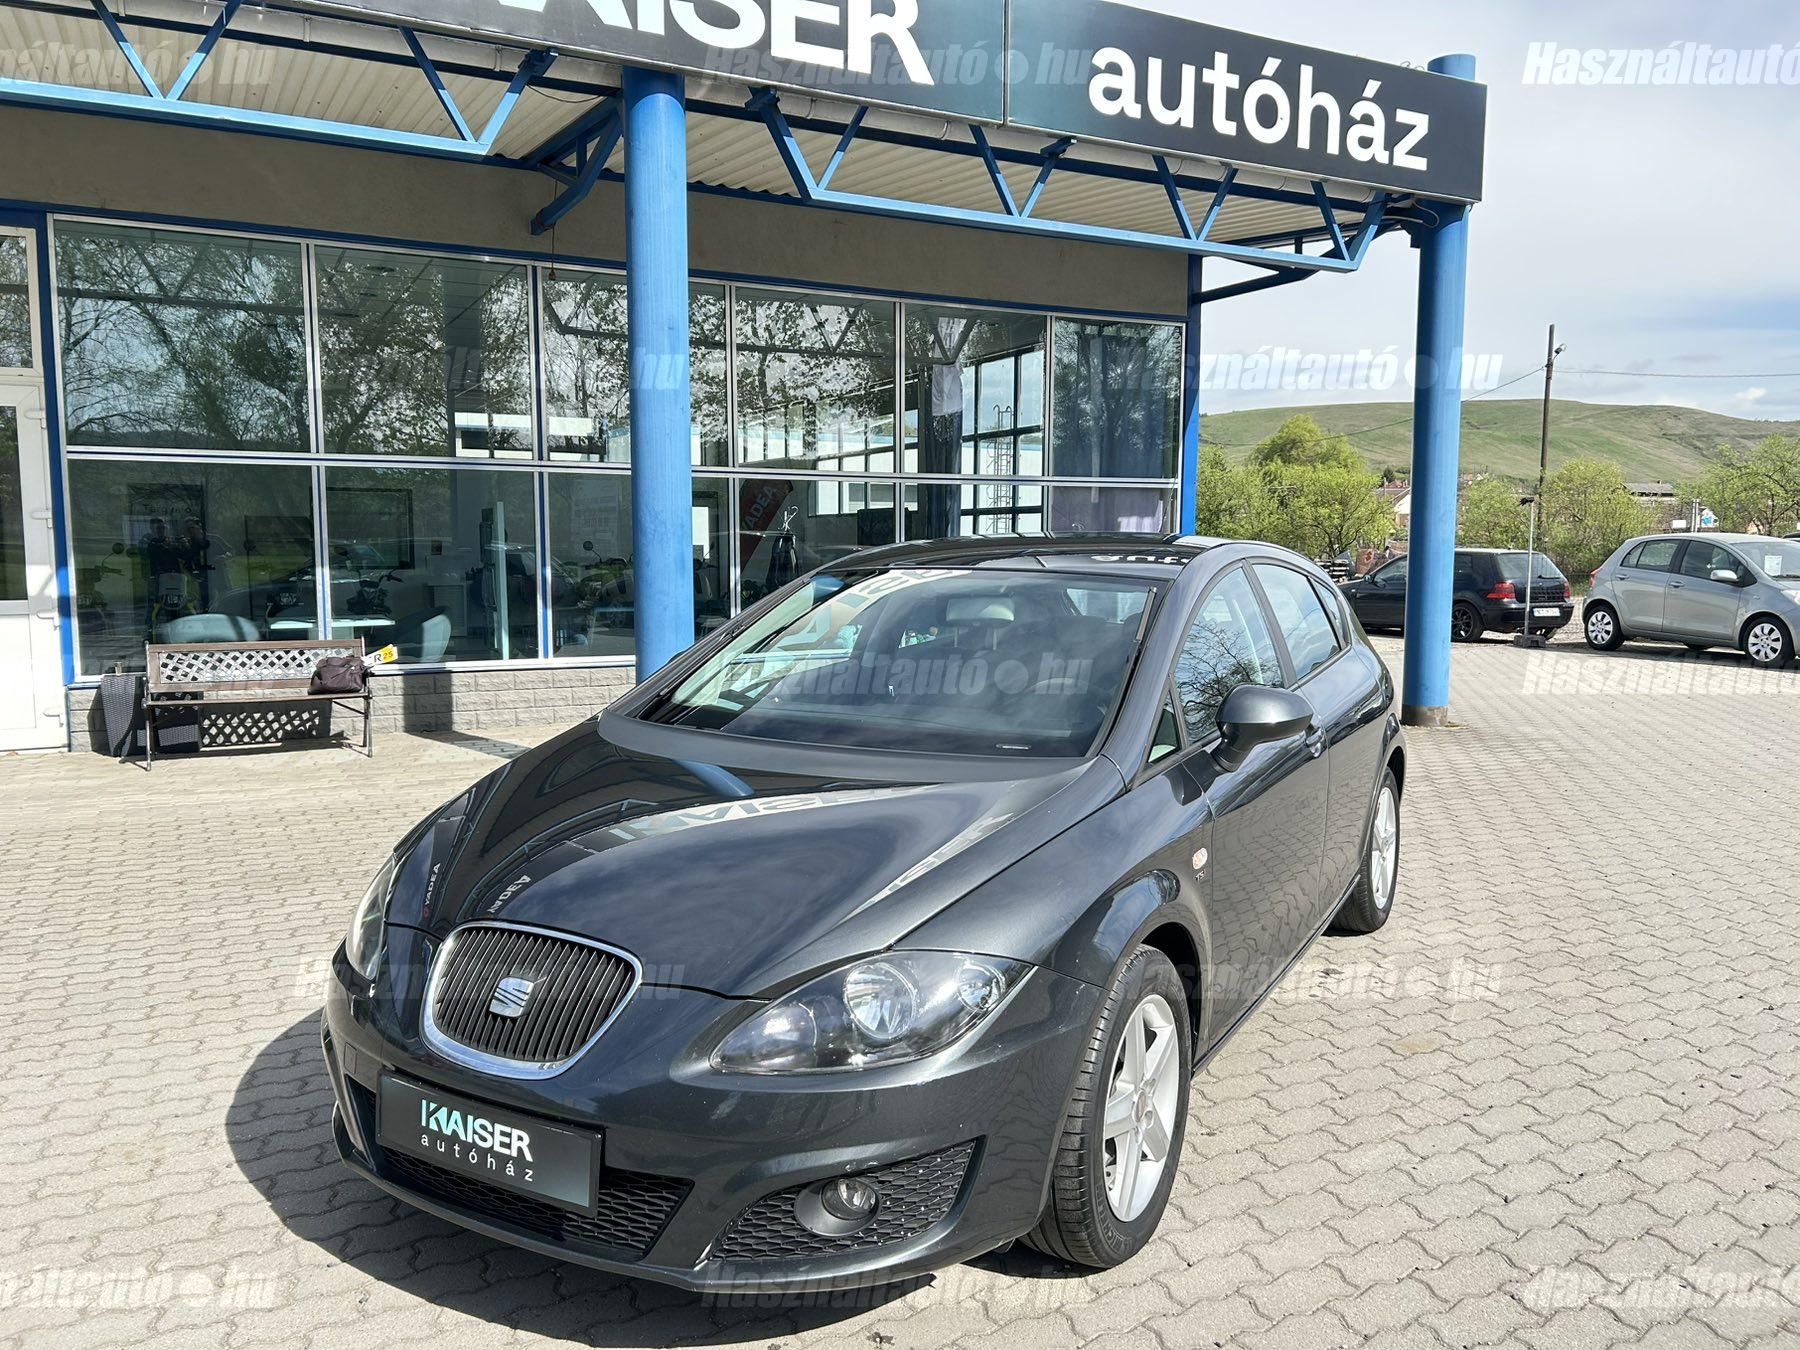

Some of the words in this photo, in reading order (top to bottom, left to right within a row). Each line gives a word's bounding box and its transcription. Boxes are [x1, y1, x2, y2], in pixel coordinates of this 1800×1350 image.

[1088, 46, 1429, 171] autóház
[421, 1099, 533, 1162] KAISER
[421, 1134, 533, 1182] autóház
